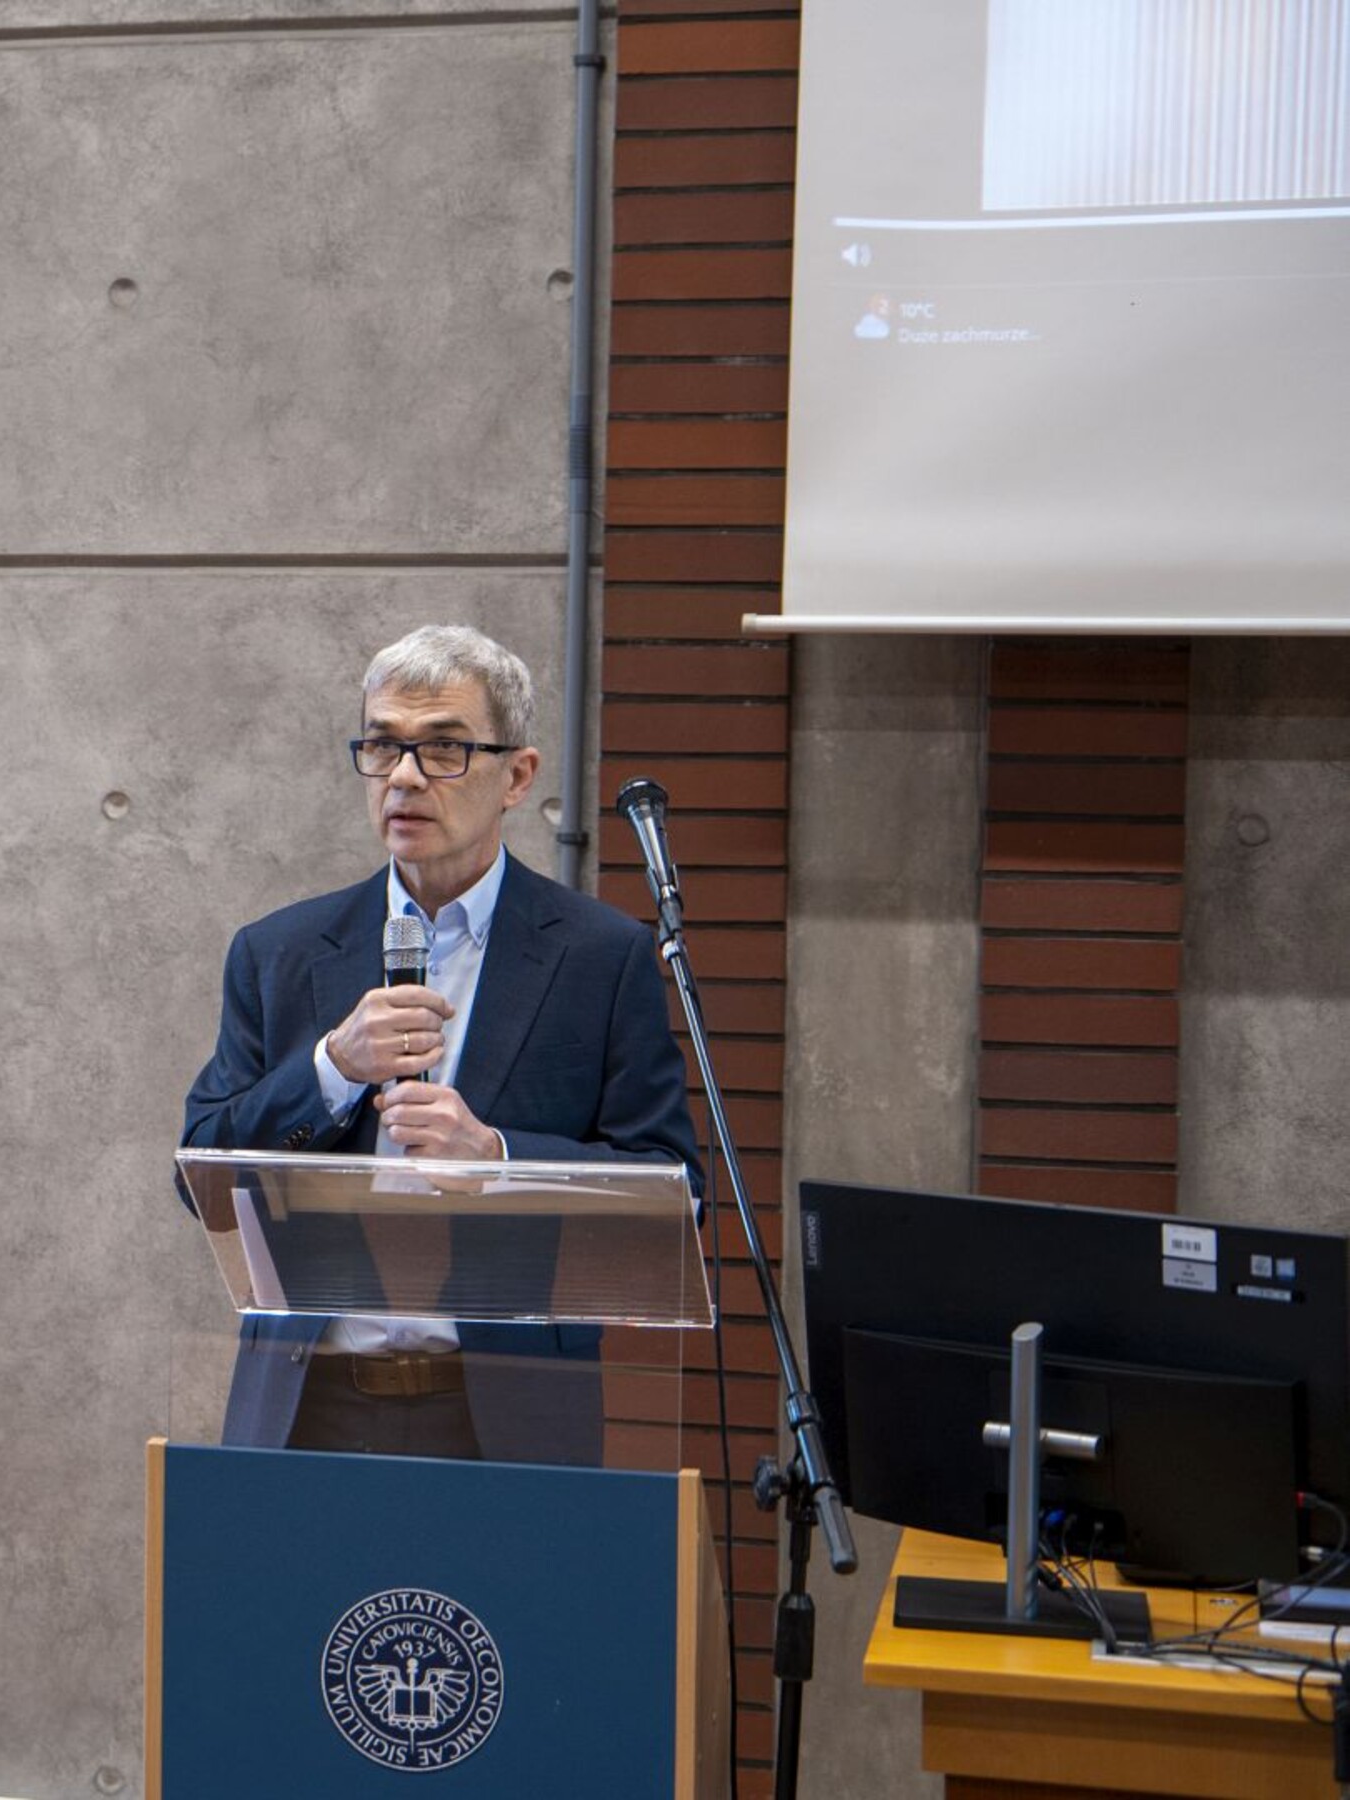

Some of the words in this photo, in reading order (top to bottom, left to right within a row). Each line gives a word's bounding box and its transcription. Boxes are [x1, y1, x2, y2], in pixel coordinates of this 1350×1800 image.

[327, 1593, 457, 1675] UNIVERSITATIS
[361, 1621, 463, 1666] CATOVICIENSIS
[393, 1640, 436, 1659] 1937
[329, 1684, 407, 1763] SIGILLUM
[419, 1620, 500, 1766] OECONOMICAE
